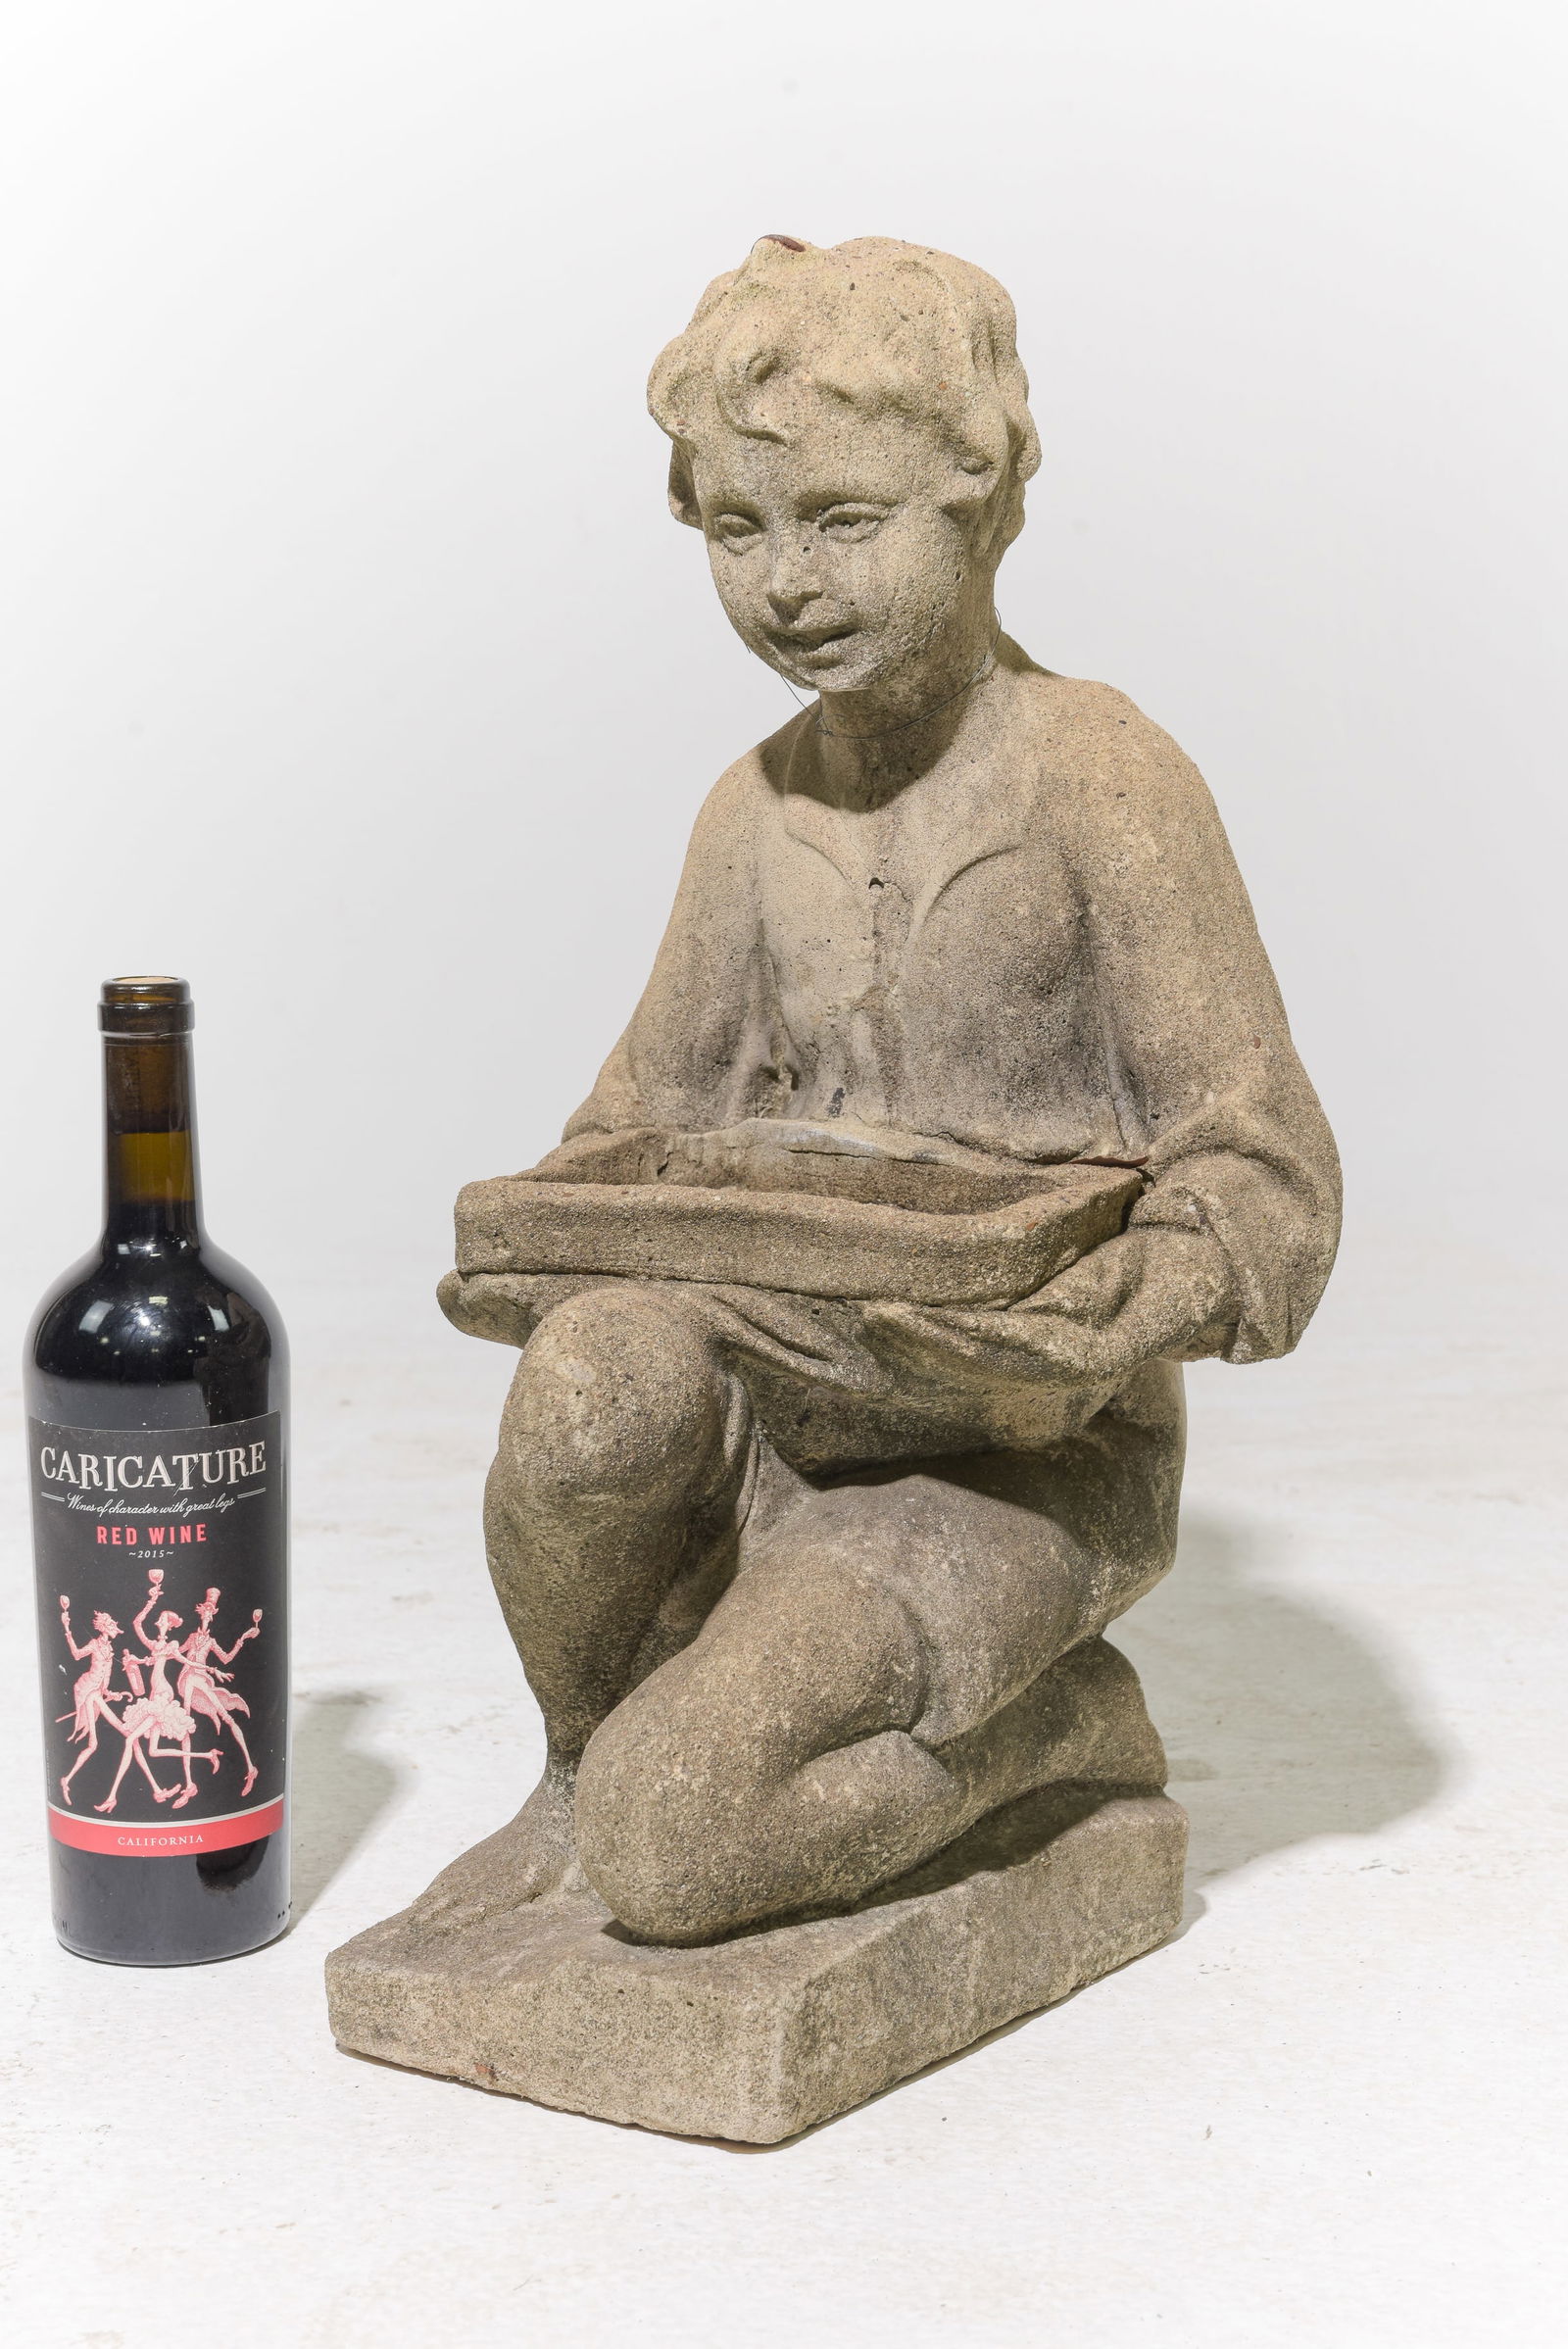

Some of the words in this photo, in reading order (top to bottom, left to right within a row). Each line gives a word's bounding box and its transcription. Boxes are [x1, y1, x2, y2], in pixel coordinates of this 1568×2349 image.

[40, 1441, 267, 1492] CARICATURE
[67, 1492, 97, 1512] Wines
[97, 1499, 111, 1517] of
[109, 1500, 159, 1515] character
[160, 1500, 185, 1514] with
[183, 1499, 215, 1518] great
[214, 1493, 235, 1513] legs
[96, 1526, 137, 1545] RED
[149, 1524, 208, 1545] WINE
[118, 1835, 204, 1846] CALIFORNIA
